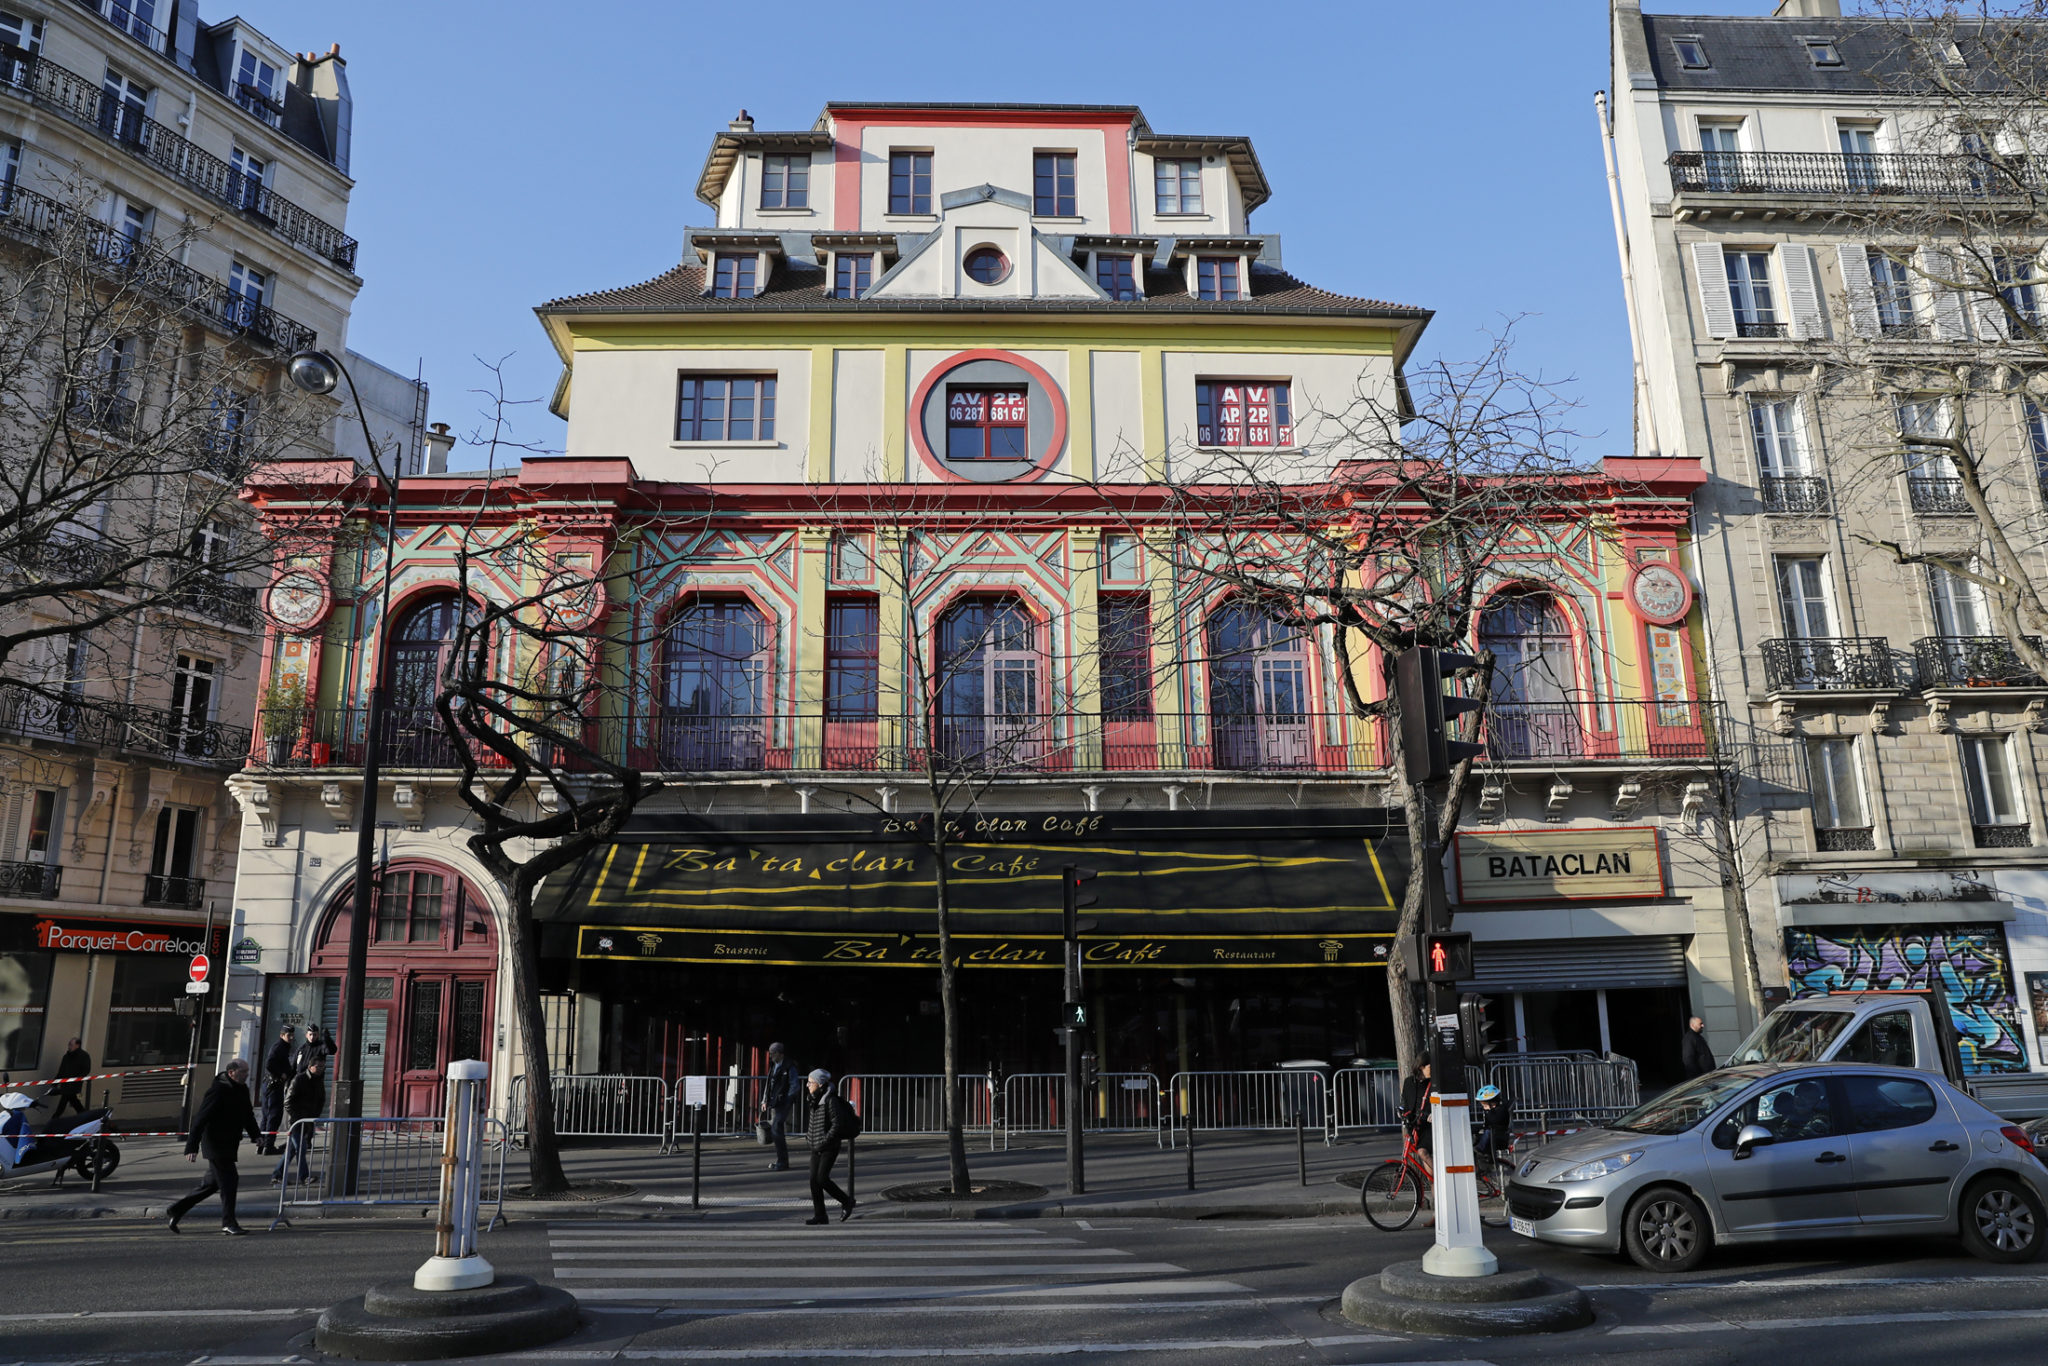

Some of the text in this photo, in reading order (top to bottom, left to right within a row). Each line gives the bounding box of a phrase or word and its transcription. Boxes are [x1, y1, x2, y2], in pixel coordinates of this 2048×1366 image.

[951, 392, 1022, 405] AV. 2P.
[950, 406, 1024, 420] 06 287 681 67
[1220, 407, 1268, 423] AP. 2P.
[1199, 427, 1290, 442] 06 287 681 67
[1042, 814, 1104, 837] Café
[952, 854, 1041, 876] Café
[1488, 852, 1632, 878] BATACLAN
[48, 925, 206, 957] Parquet-Carrelage
[713, 943, 768, 956] Brasserie
[1085, 942, 1167, 964] Café
[1213, 948, 1277, 959] Restaurant
